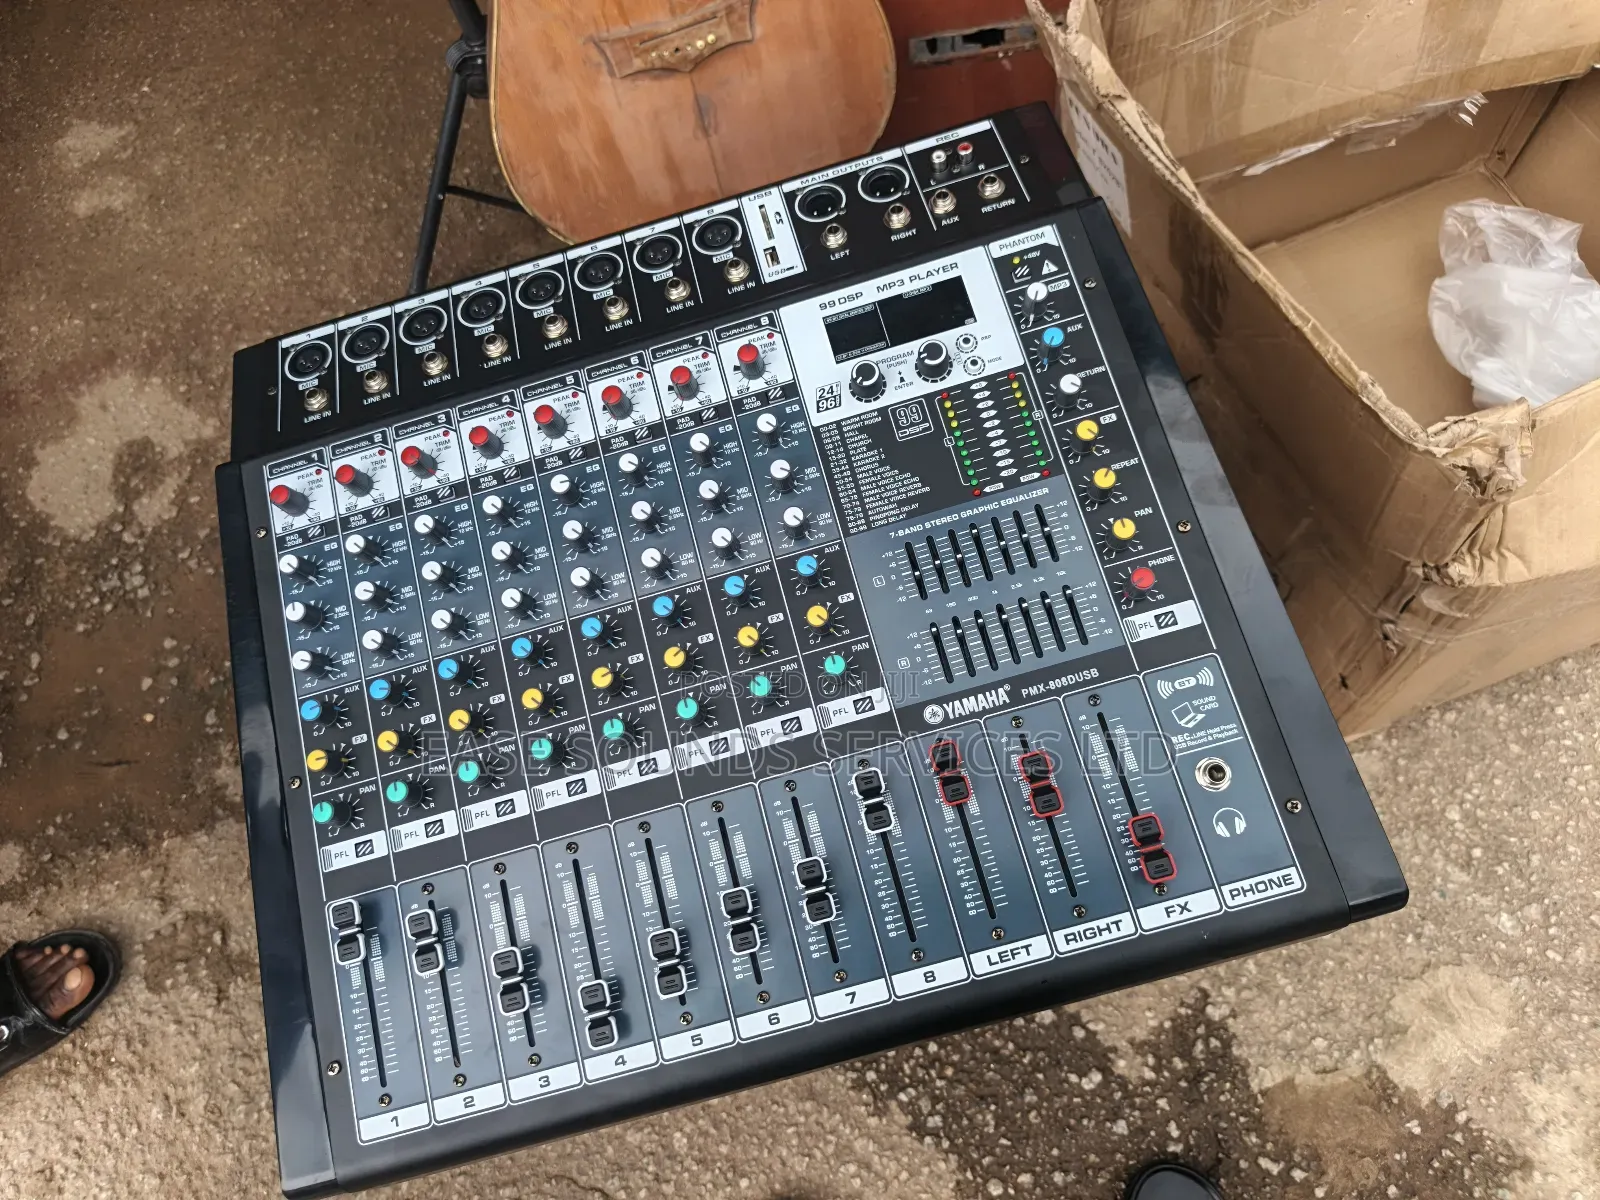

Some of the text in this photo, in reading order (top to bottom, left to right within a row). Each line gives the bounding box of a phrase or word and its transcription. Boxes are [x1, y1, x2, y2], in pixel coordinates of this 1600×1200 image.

[936, 132, 960, 144] REC
[800, 156, 884, 186] MAIN OUTPUTS
[981, 199, 1016, 214] RETURN
[941, 215, 960, 226] AUX
[890, 228, 917, 242] RIGHT
[998, 232, 1046, 252] PHANTOM
[830, 250, 850, 260] LEFT
[876, 278, 906, 294] MP3
[908, 262, 960, 284] PLAYER
[728, 281, 755, 294] LINE IN
[1049, 281, 1068, 292] MP3
[666, 300, 694, 313] LINE IN
[819, 291, 864, 312] 99 DSP
[605, 319, 633, 332] LINE IN
[721, 316, 770, 338] CHANNEL 8
[1067, 323, 1084, 333] AUX
[544, 337, 572, 350] LINE IN
[656, 337, 703, 358] CHANNEL 7
[484, 358, 502, 368] LINE
[876, 350, 915, 365] PROGRAM
[591, 356, 639, 377] CHANNEL 6
[887, 359, 908, 369] (PUSH)
[1076, 366, 1106, 378] RETURN
[423, 377, 441, 387] LINE
[527, 376, 574, 397] CHANNEL 5
[894, 382, 914, 391] ENTER
[818, 387, 834, 399] 24
[363, 396, 381, 405] LINE
[462, 395, 510, 416] CHANNEL 4
[818, 398, 835, 411] 96
[785, 405, 800, 414] EQ
[896, 403, 923, 426] 99
[304, 410, 331, 423] LINE IN
[1102, 414, 1115, 423] FX
[398, 414, 446, 435] CHANNEL 3
[718, 424, 733, 433] EQ
[898, 423, 930, 436] DSP
[335, 433, 382, 455] CHANNEL 2
[652, 444, 666, 453] EQ
[273, 460, 308, 474] CHANNEL
[586, 464, 600, 473] EQ
[1111, 458, 1139, 471] REPEAT
[520, 483, 534, 492] EQ
[454, 503, 469, 513] EQ
[889, 487, 1050, 539] 7-BAND STEREO GRAPHIC EQUALIZER
[1134, 506, 1152, 518] PAN
[389, 523, 403, 532] EQ
[324, 542, 338, 551] EQ
[824, 544, 840, 554] AUX
[1148, 554, 1175, 567] PHONE
[755, 564, 771, 574] AUX
[686, 585, 701, 594] AUX
[839, 594, 852, 602] FX
[617, 605, 633, 614] AUX
[769, 614, 783, 622] FX
[548, 625, 564, 634] AUX
[1138, 621, 1154, 630] PFL
[699, 634, 713, 643] FX
[480, 645, 496, 654] AUX
[851, 642, 870, 652] PAN
[629, 654, 642, 663] FX
[412, 665, 428, 674] AUX
[780, 662, 798, 673] PAN
[560, 675, 573, 683] FX
[1021, 667, 1100, 698] PMX-808DUSB
[1176, 678, 1193, 688] BT
[344, 684, 360, 694] AUX
[709, 683, 727, 693] PAN
[1192, 696, 1216, 706] SOUND
[1200, 702, 1219, 711] CARD
[638, 703, 656, 714] PAN
[832, 707, 849, 717] PFL
[422, 715, 435, 723] FX
[568, 724, 586, 734] PAN
[760, 728, 776, 738] PFL
[498, 743, 516, 754] PAN
[688, 748, 704, 758] PFL
[428, 764, 446, 775] PAN
[616, 769, 633, 779] PFL
[359, 784, 376, 794] PAN
[546, 789, 561, 799] PFL
[474, 810, 490, 820] PFL
[404, 831, 419, 840] PFL
[334, 850, 349, 860] PFL
[1228, 874, 1295, 900] PHONE
[1164, 901, 1192, 918] FX
[1064, 920, 1123, 945] RIGHT
[987, 944, 1033, 966] LEFT
[923, 970, 936, 983] 8
[845, 991, 857, 1004] 7
[768, 1013, 781, 1025] 6
[690, 1034, 703, 1046] 5
[614, 1054, 627, 1067] 4
[538, 1075, 551, 1089] 3
[462, 1095, 476, 1108] 2
[390, 1116, 399, 1128] 1
